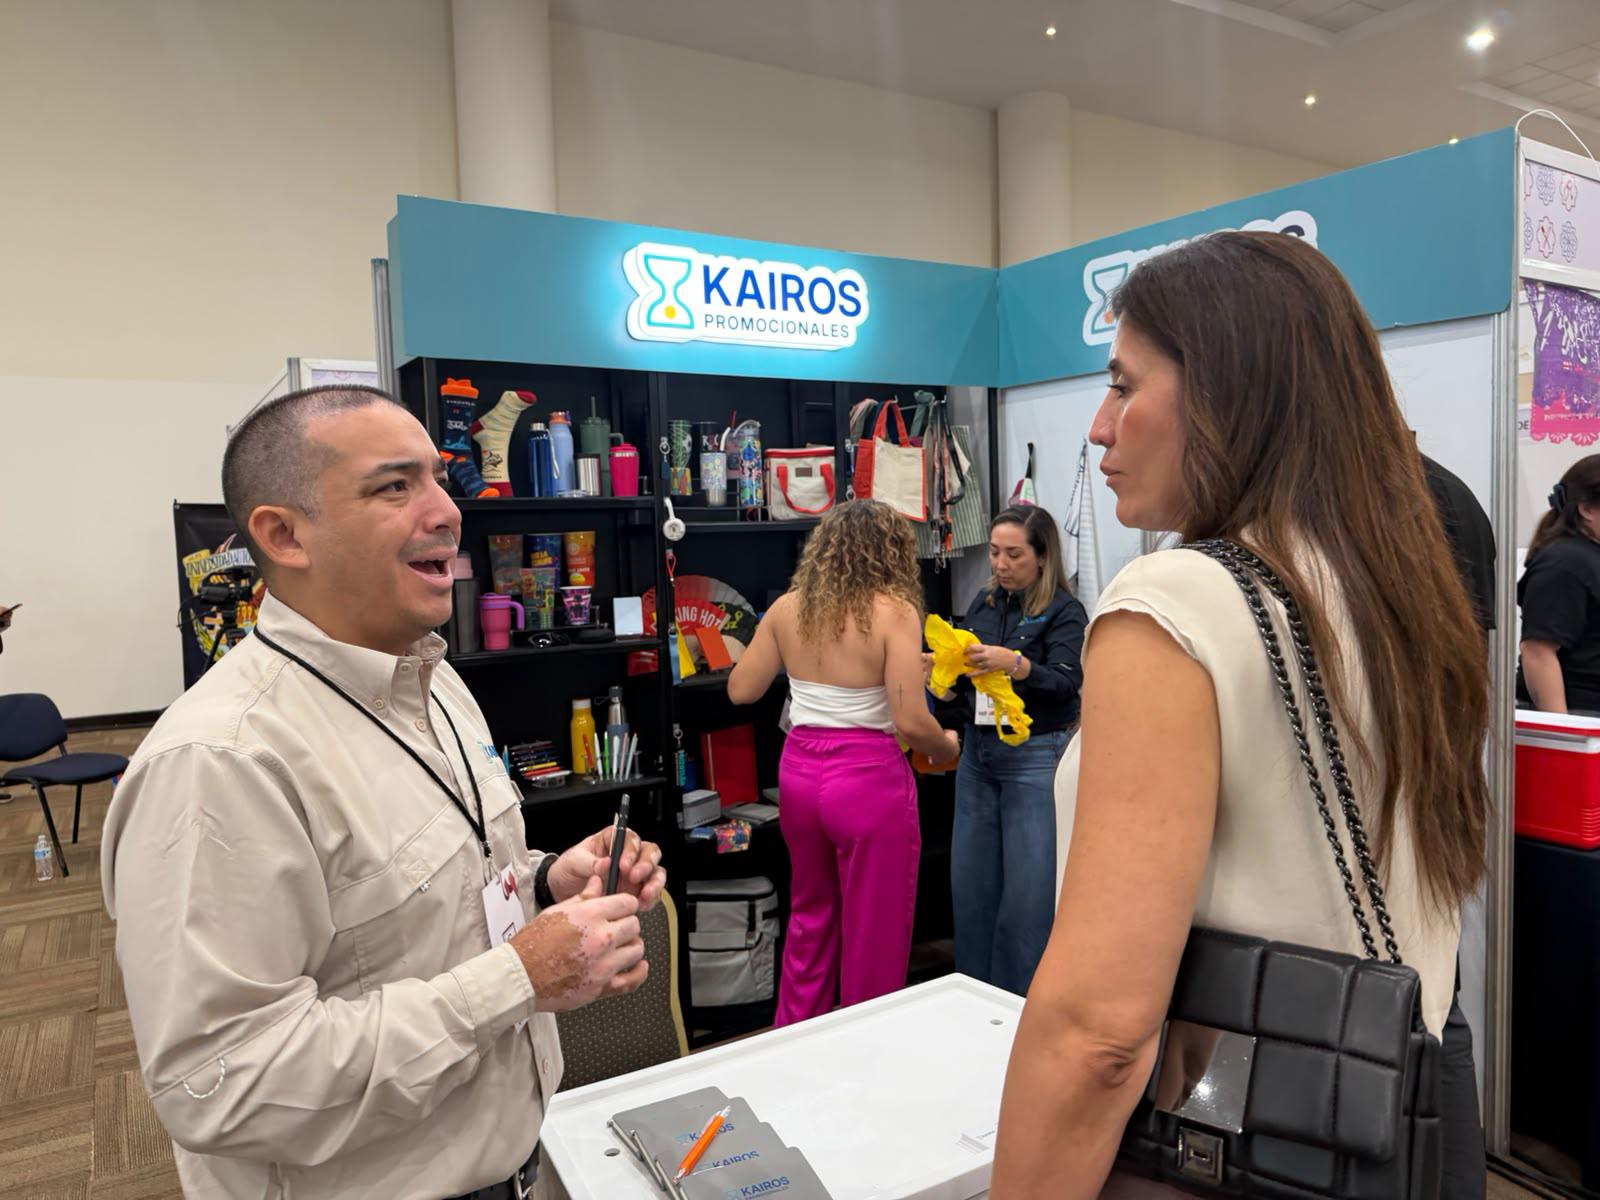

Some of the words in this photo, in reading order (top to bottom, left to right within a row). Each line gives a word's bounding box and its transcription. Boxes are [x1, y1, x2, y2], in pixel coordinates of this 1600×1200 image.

[703, 264, 861, 317] KAIROS
[704, 314, 849, 338] PROMOCIONALES
[741, 1176, 790, 1197] KAIROS
